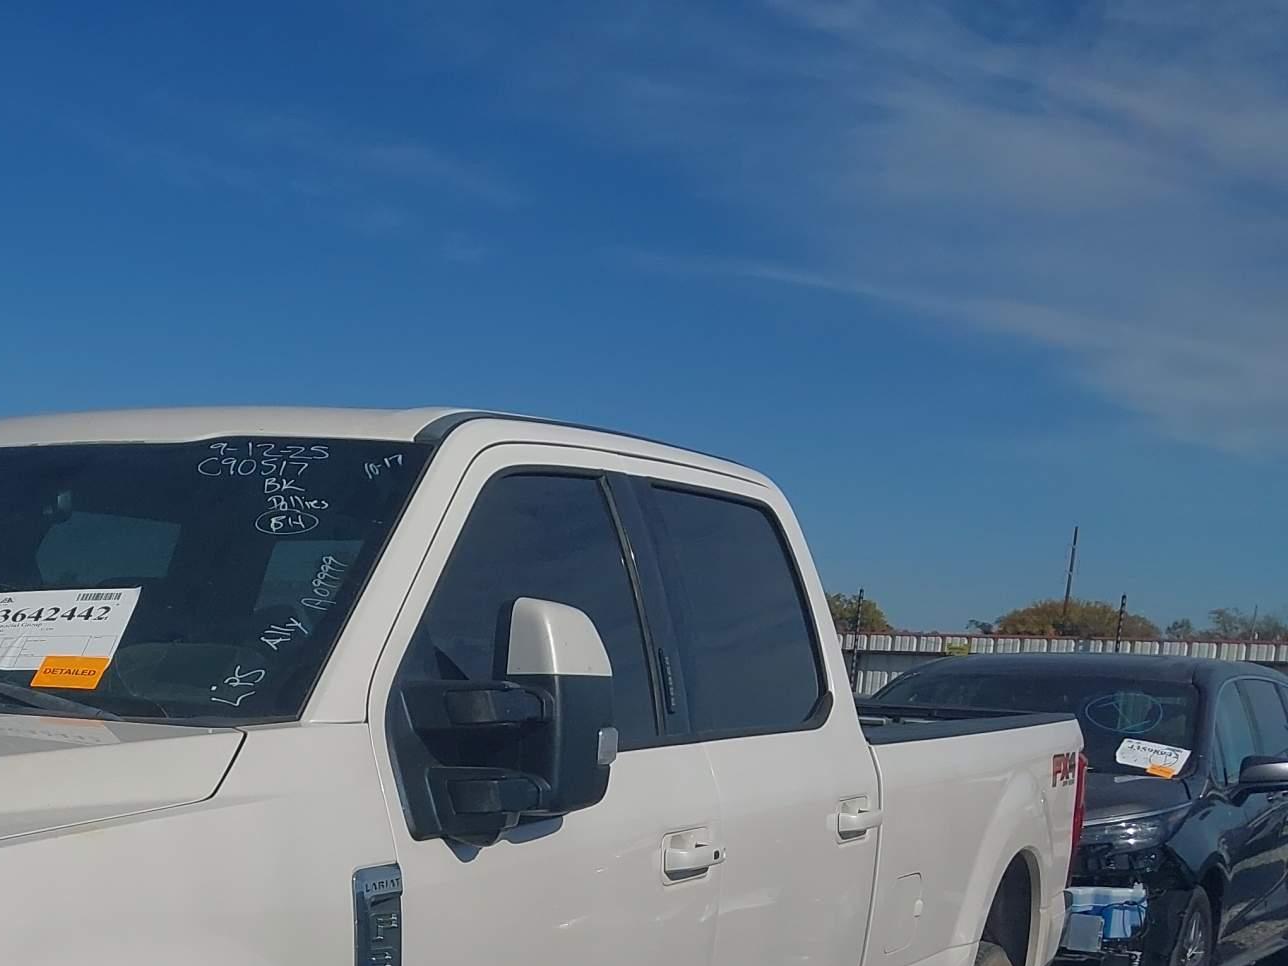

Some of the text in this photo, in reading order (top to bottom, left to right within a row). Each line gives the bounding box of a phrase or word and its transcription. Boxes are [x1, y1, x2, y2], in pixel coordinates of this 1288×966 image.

[210, 442, 329, 460] 9-12-25
[197, 457, 309, 477] C90517
[264, 477, 306, 494] BK
[260, 617, 309, 650] Ally
[42, 667, 97, 677] DETAILED
[364, 878, 401, 893] LARIAT
